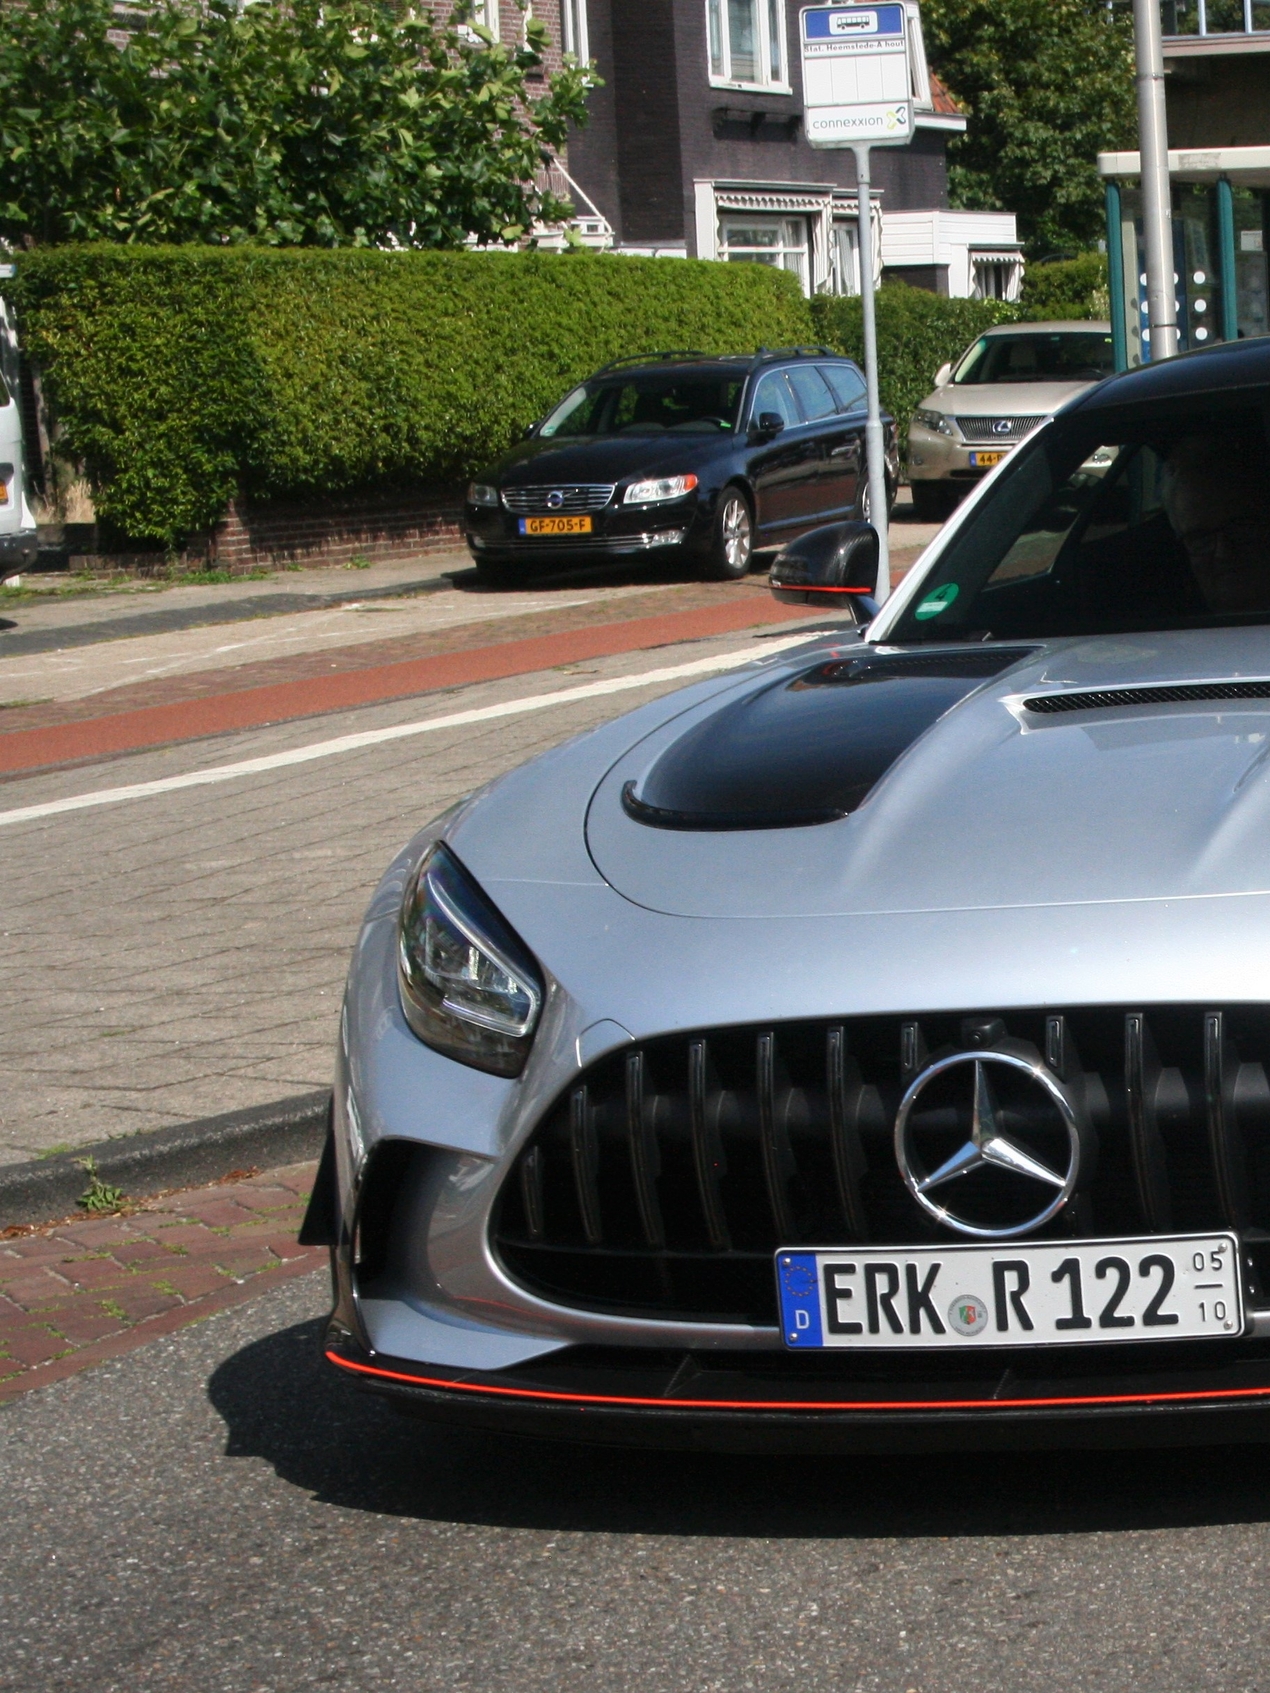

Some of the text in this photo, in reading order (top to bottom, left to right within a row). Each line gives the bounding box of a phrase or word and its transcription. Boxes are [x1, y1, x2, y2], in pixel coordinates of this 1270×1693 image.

[812, 116, 883, 129] connexxion
[530, 519, 586, 532] GF-705-F
[1193, 1251, 1223, 1272] 05
[823, 1262, 947, 1334] ERK
[992, 1259, 1035, 1332] R
[1051, 1254, 1179, 1330] 122
[795, 1309, 810, 1329] D
[1199, 1301, 1226, 1322] 10
